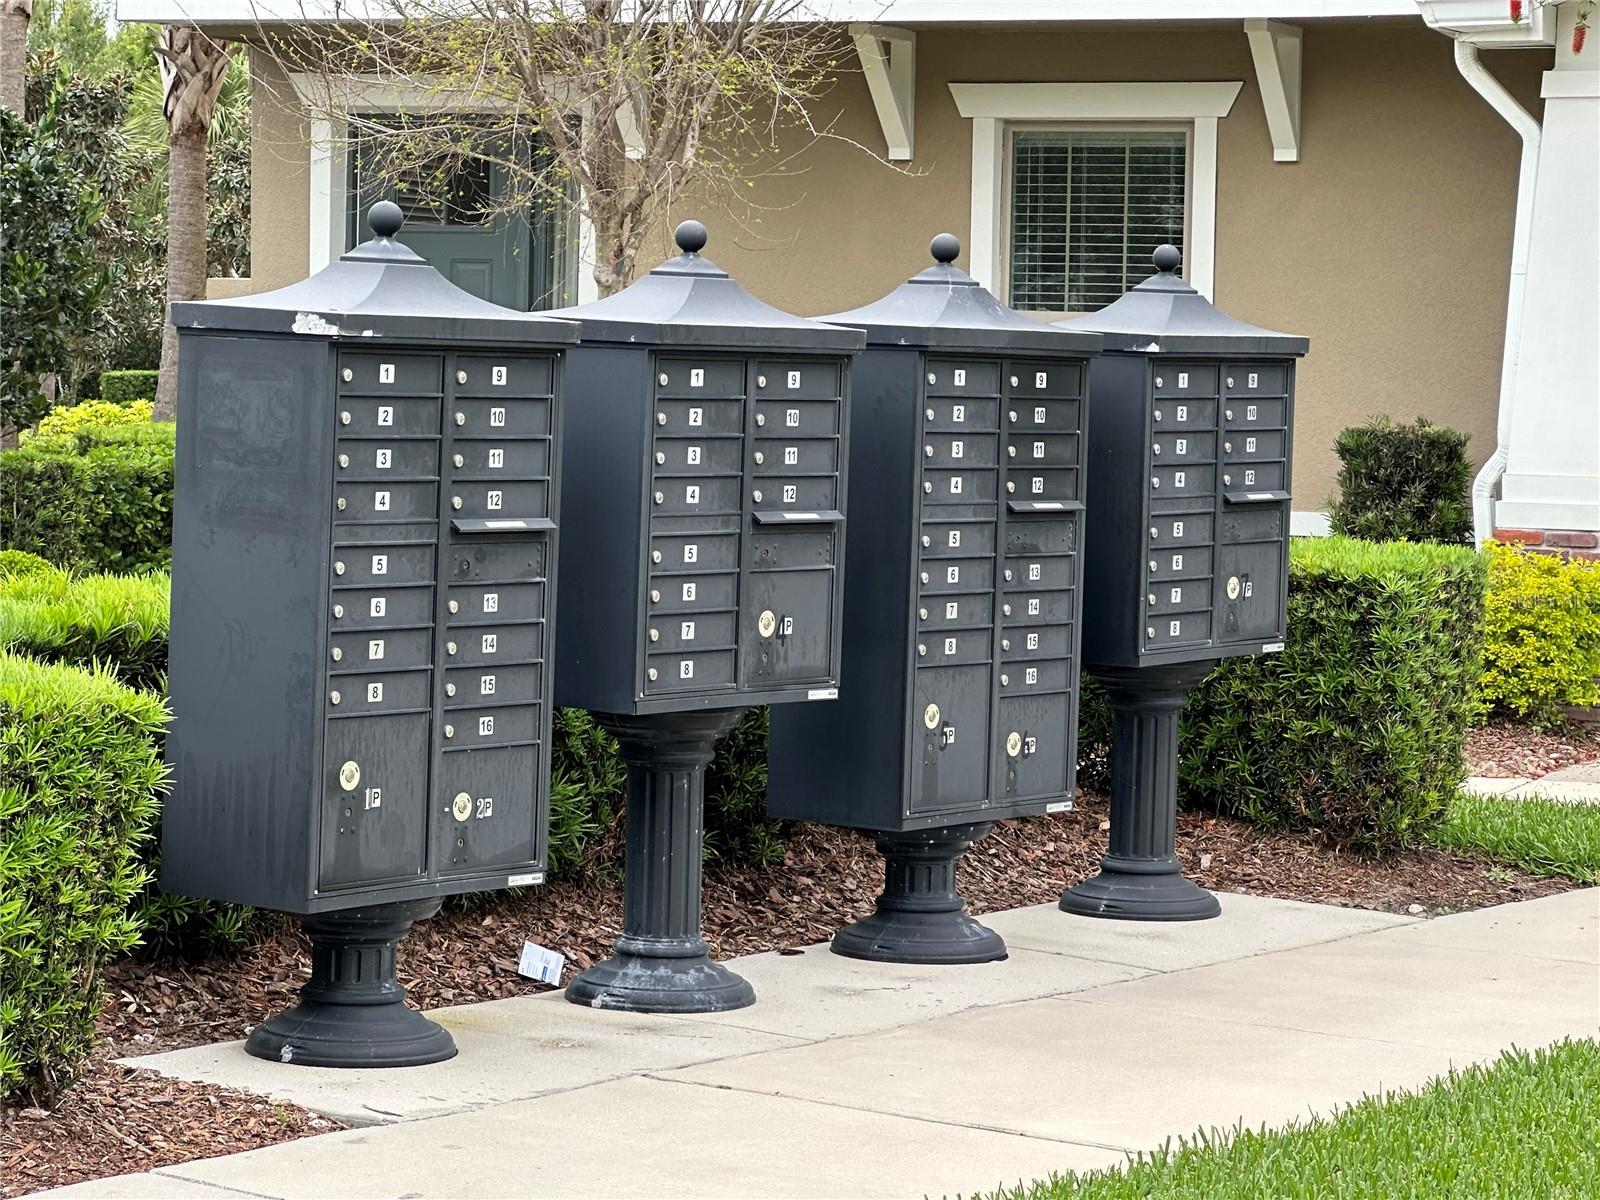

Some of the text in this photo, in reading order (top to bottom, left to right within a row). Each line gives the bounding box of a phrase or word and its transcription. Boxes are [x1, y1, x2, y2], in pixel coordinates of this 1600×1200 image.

[491, 410, 505, 425] 10
[787, 411, 799, 425] 10
[1035, 409, 1046, 422] 10
[1248, 407, 1256, 419] 10
[1034, 443, 1044, 456] 11
[1247, 439, 1255, 451] 11
[490, 451, 502, 465] 11
[786, 449, 797, 462] 11
[1246, 471, 1255, 484] 12
[1033, 478, 1043, 492] 12
[488, 493, 501, 507] 12
[784, 487, 796, 501] 12
[1030, 566, 1040, 579] 13
[484, 596, 497, 610] 13
[1029, 600, 1039, 613] 14
[483, 636, 496, 651] 14
[1028, 635, 1038, 648] 15
[1027, 670, 1037, 682] 16
[482, 677, 495, 692] 15
[480, 718, 493, 733] 16
